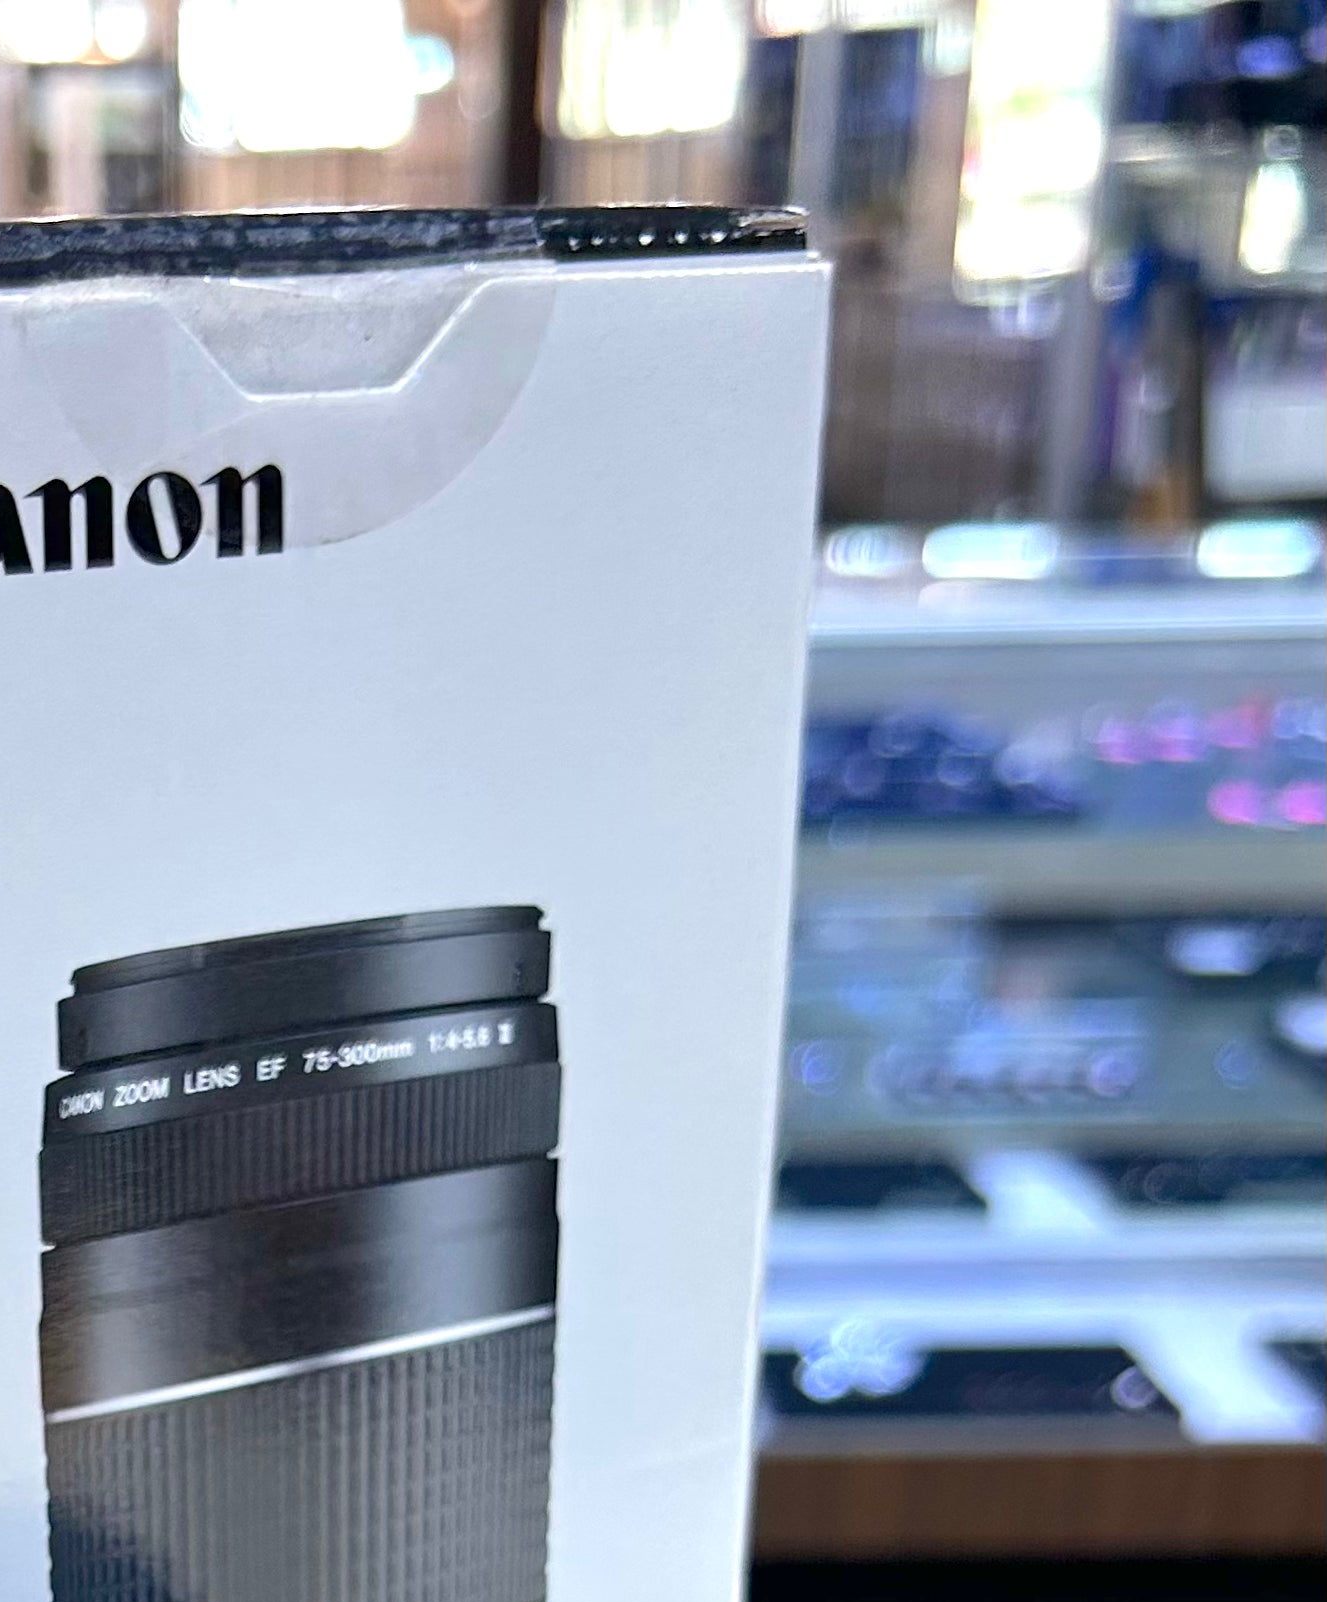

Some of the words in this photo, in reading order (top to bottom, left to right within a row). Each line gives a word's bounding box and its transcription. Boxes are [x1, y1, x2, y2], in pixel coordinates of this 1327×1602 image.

[113, 1077, 170, 1107] ZOOM
[183, 1058, 242, 1095] LENS
[256, 1056, 288, 1083] EF
[302, 1038, 414, 1074] 75-300mm
